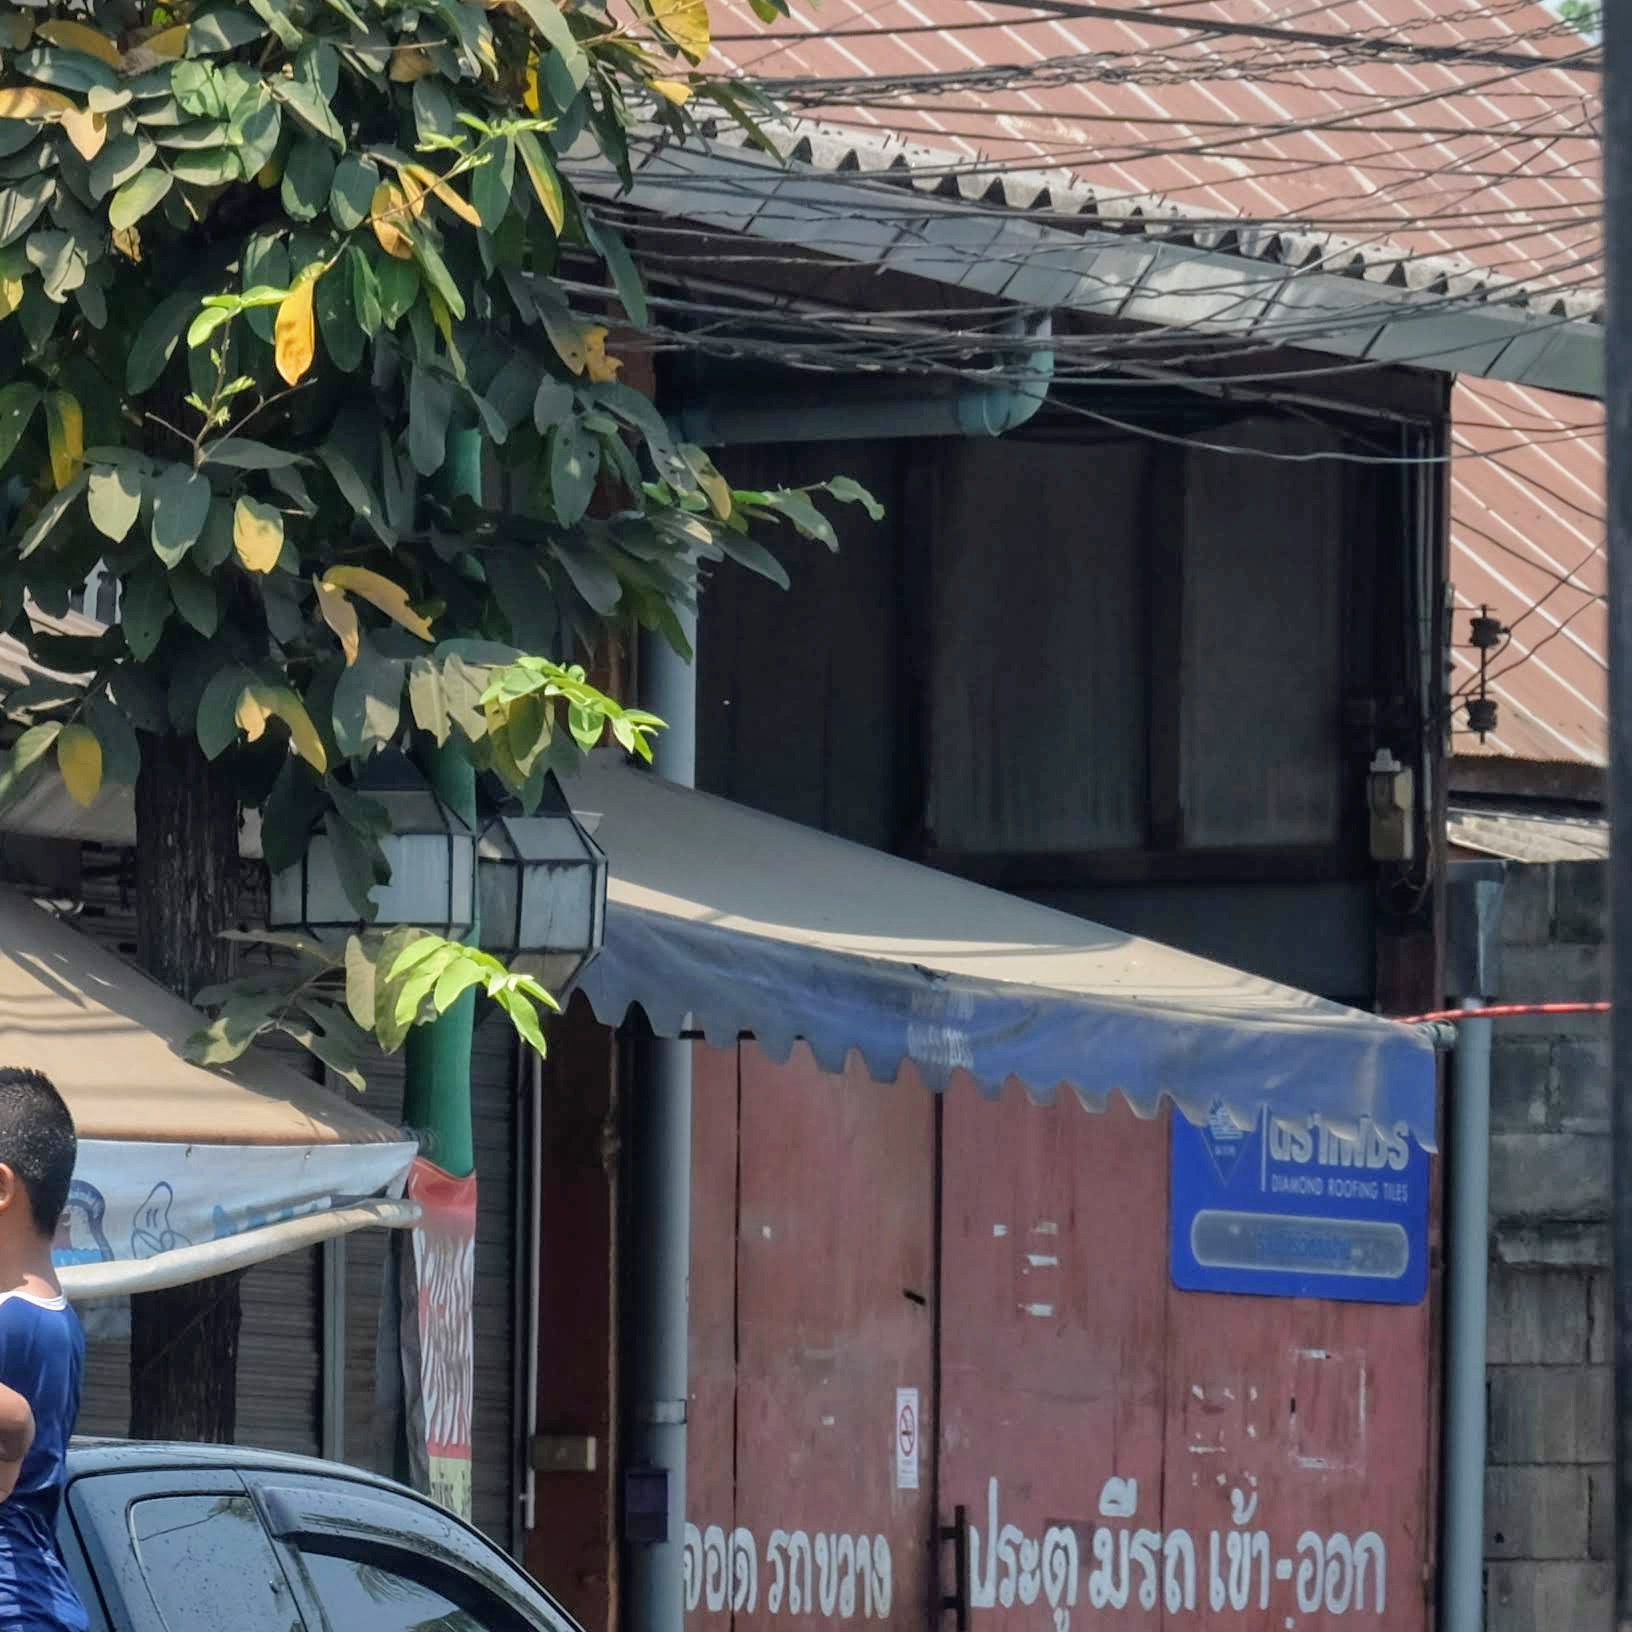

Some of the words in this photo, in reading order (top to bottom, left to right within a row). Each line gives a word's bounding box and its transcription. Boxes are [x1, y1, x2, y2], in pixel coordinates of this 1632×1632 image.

[1271, 1173, 1324, 1197] DIAMOND
[1327, 1177, 1379, 1201] ROOFING
[1383, 1182, 1410, 1204] TILES
[767, 1529, 892, 1619] รถขวาง
[1209, 1488, 1386, 1614] เข้า-ออก
